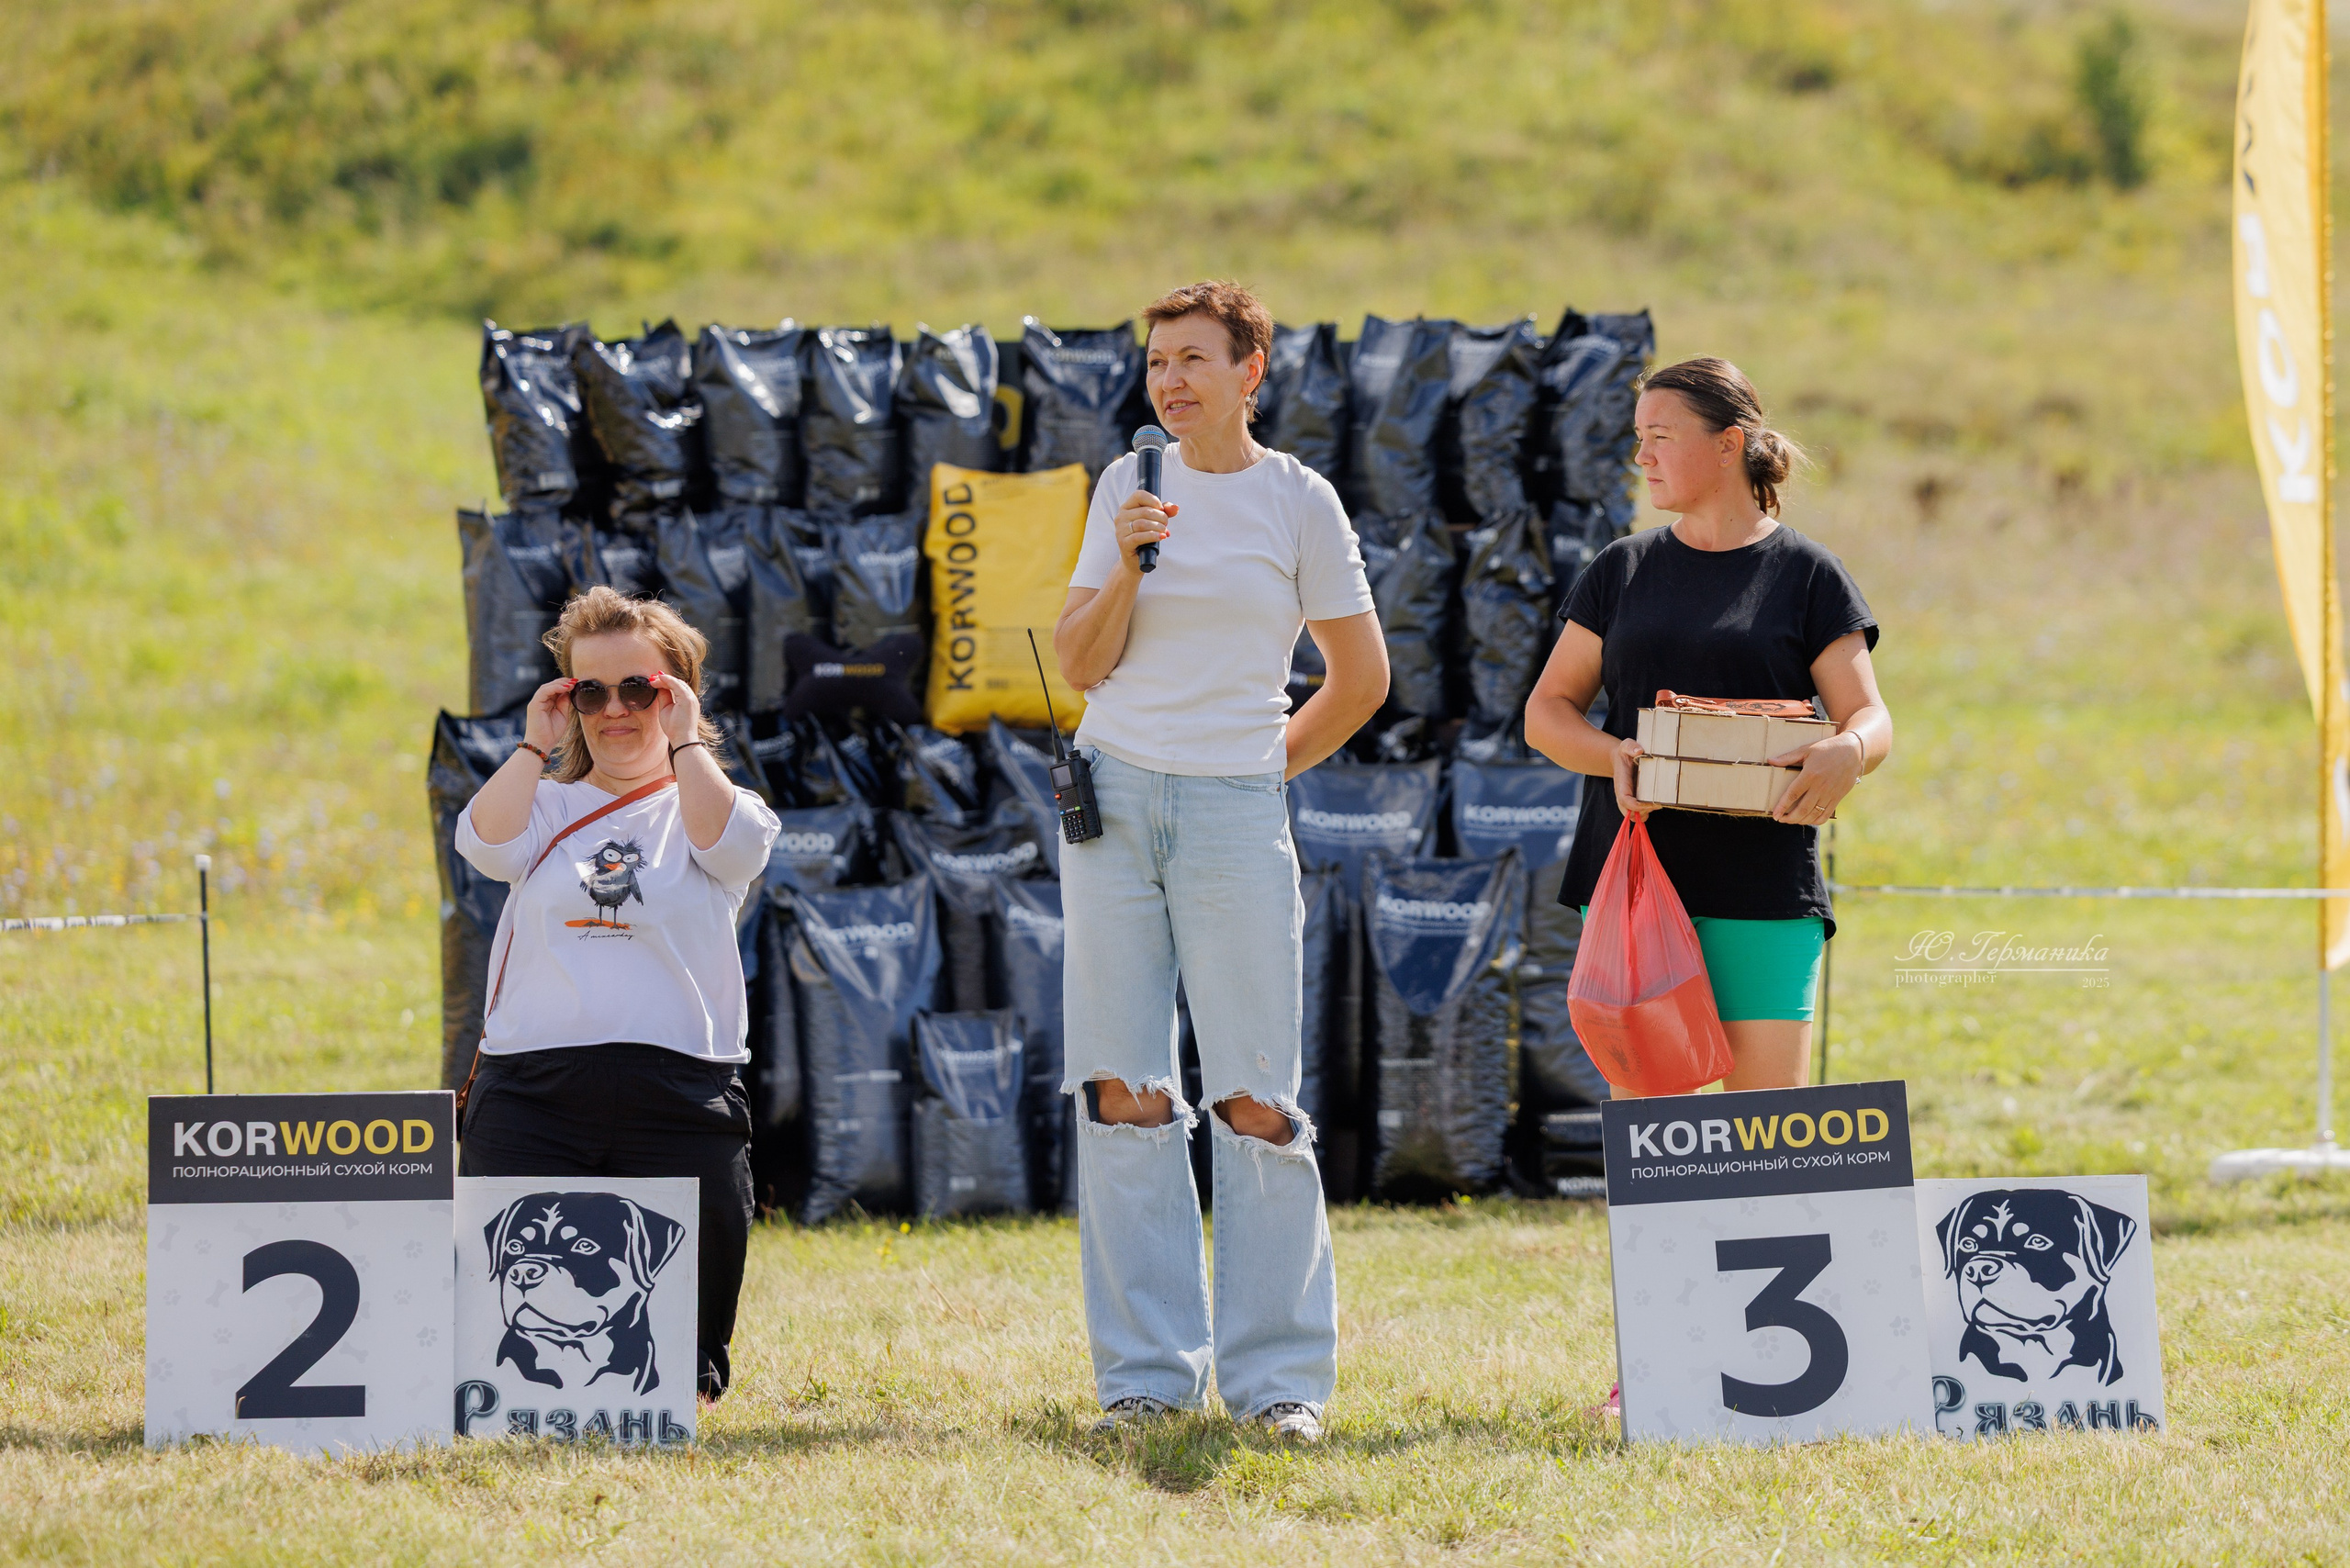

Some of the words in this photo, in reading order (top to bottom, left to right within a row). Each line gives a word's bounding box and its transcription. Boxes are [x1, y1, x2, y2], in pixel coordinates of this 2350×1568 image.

[944, 482, 979, 690] KORWOOD
[173, 1118, 434, 1157] KORWOOD
[1628, 1108, 1889, 1159] KORWOOD
[173, 1162, 330, 1179] ПОЛНОРАЦИОННЫЙ
[334, 1161, 386, 1176] СУХОЙ
[389, 1163, 432, 1175] КОРМ
[1631, 1156, 1789, 1179] ПОЛНОРАЦИОННЫЙ
[1792, 1152, 1844, 1169] СУХОЙ
[1847, 1151, 1891, 1165] КОРМ
[236, 1239, 366, 1419] 2
[1715, 1233, 1849, 1418] 3
